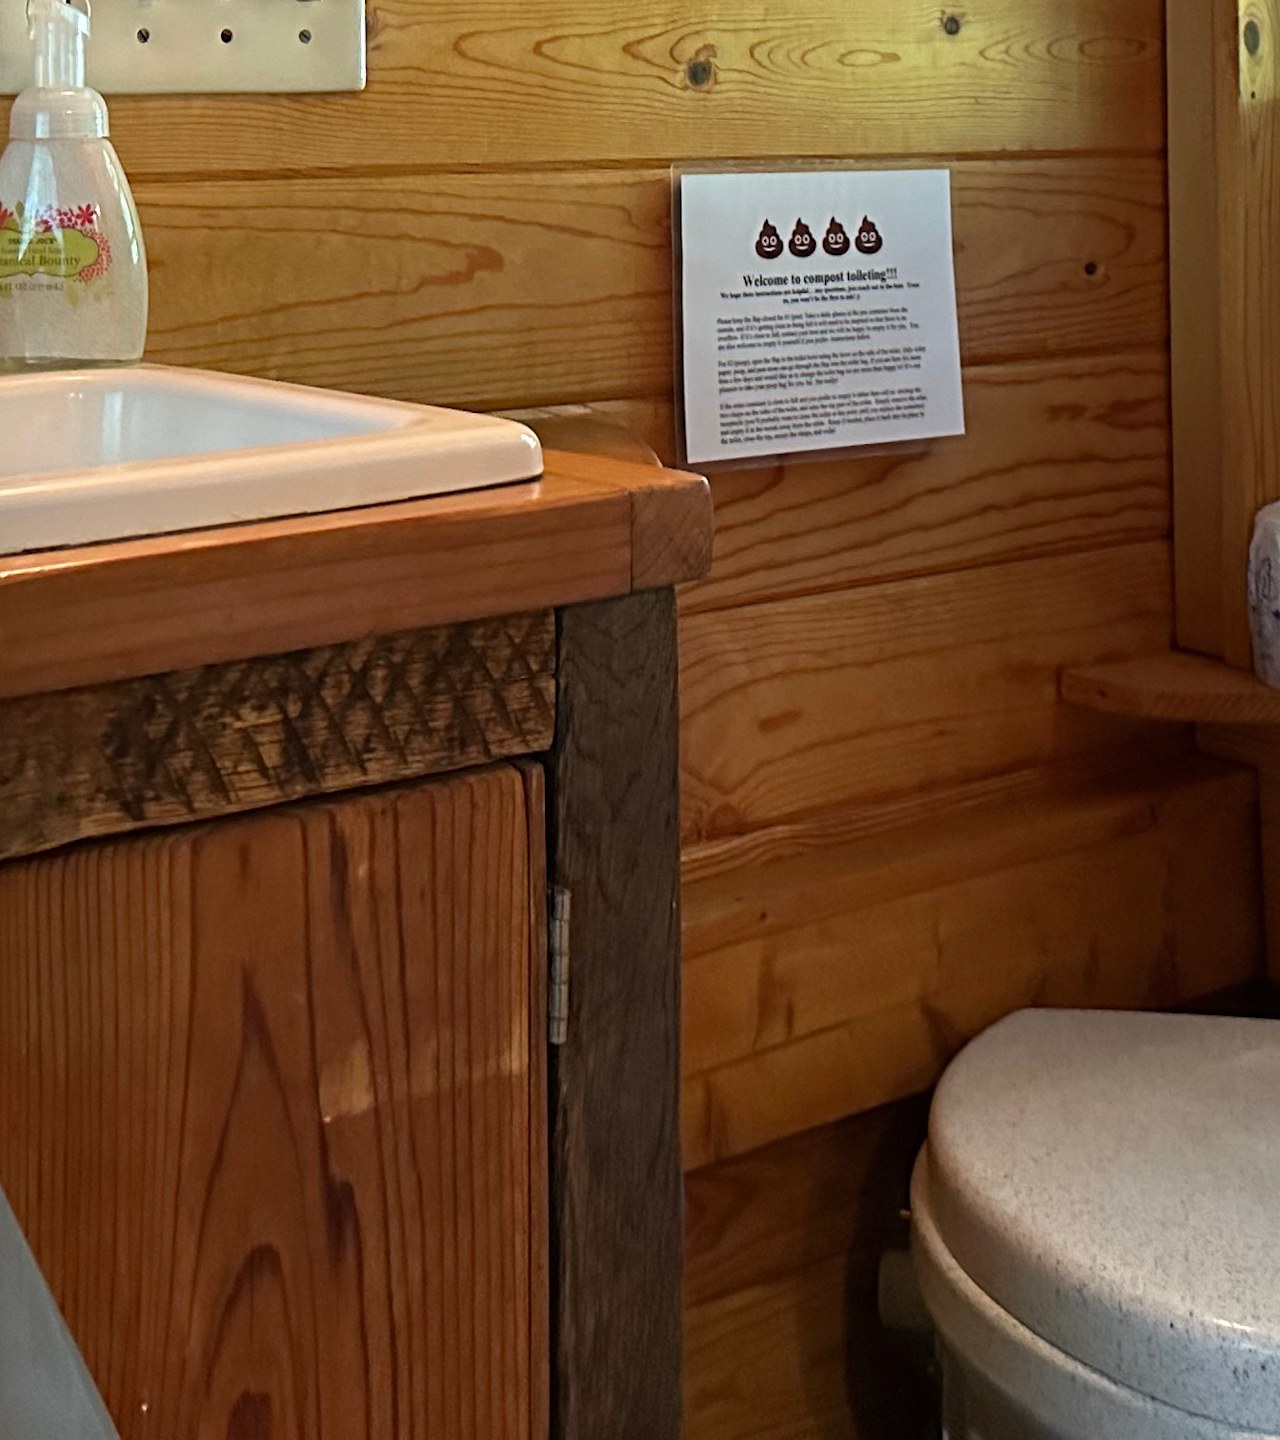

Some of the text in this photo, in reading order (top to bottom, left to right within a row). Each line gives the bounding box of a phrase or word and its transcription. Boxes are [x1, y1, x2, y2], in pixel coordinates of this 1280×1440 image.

[39, 254, 81, 268] Bounty
[743, 274, 788, 288] Welcome
[791, 274, 801, 286] to
[803, 272, 844, 287] compost
